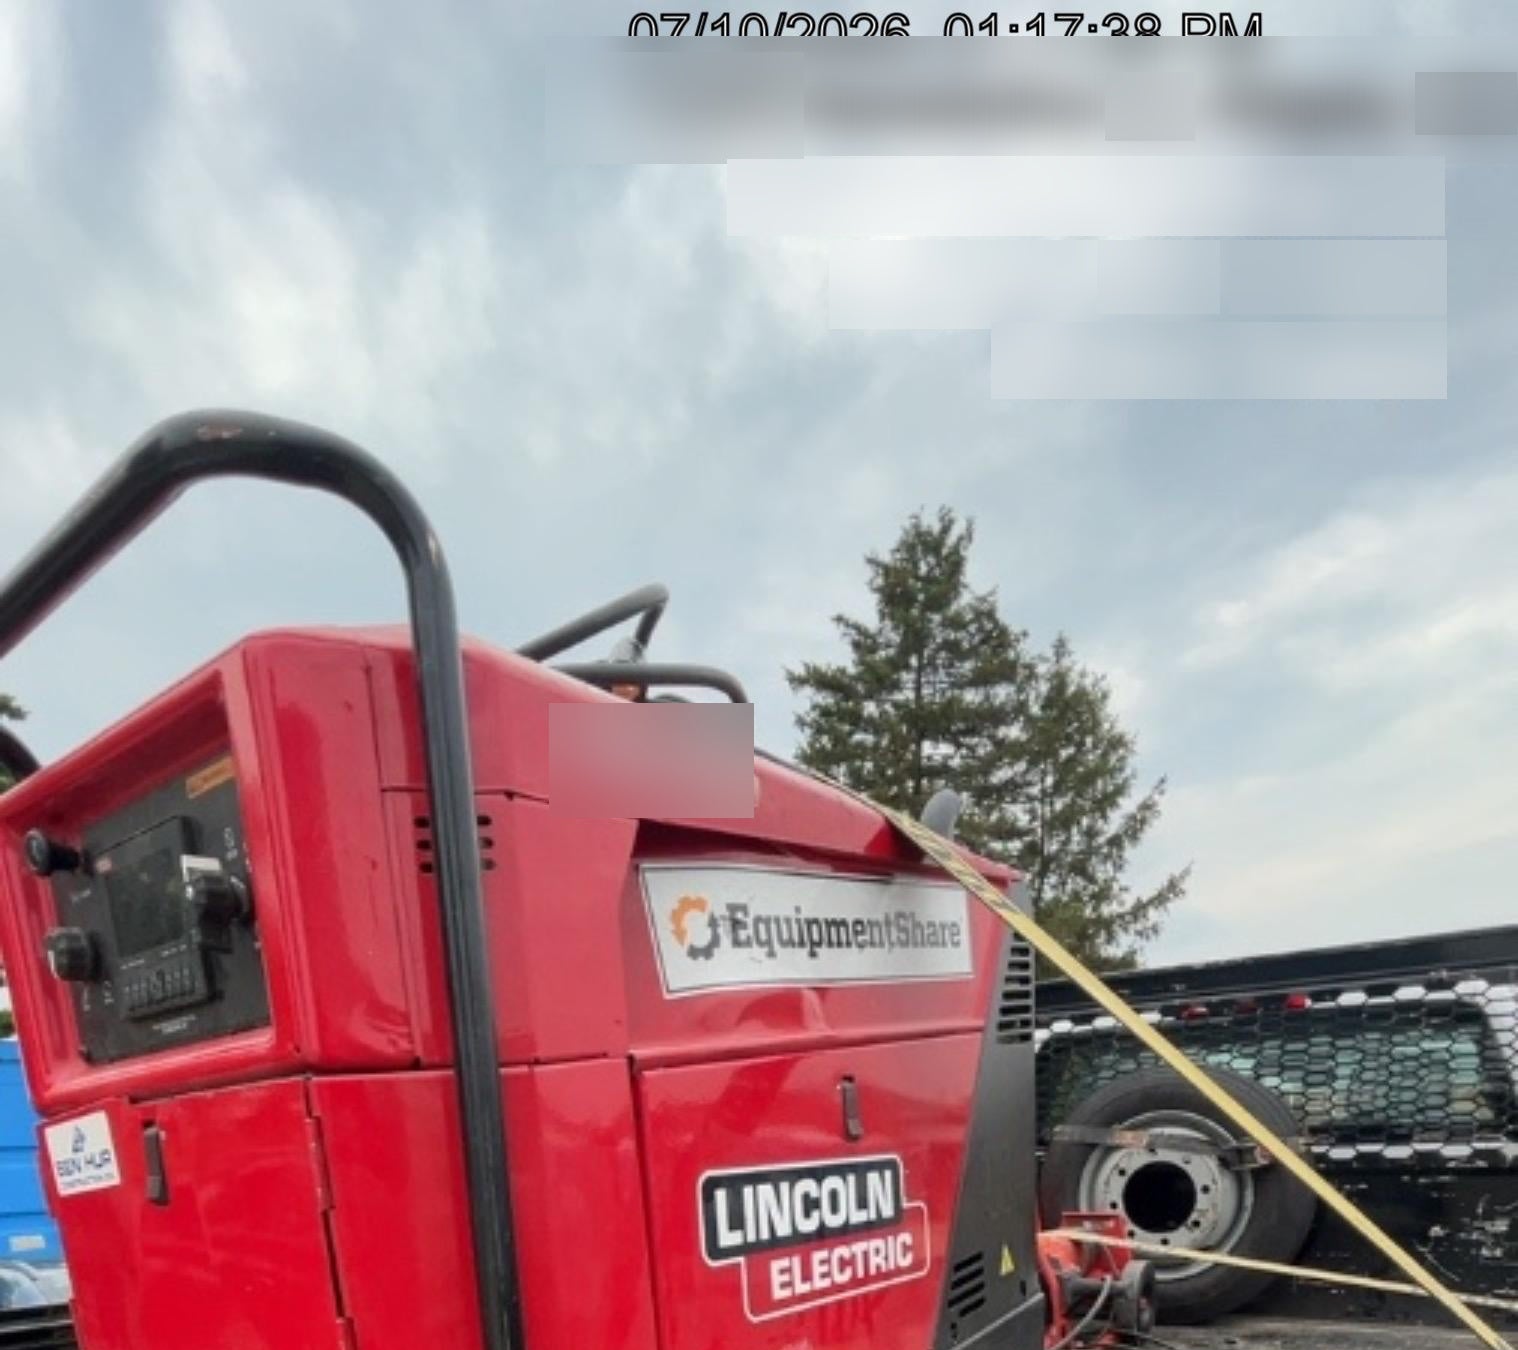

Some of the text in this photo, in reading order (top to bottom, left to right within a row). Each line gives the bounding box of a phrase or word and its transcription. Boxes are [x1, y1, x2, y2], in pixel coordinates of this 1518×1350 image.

[725, 902, 961, 959] EquipmentShare
[714, 1169, 895, 1249] LINCOLN
[769, 1231, 914, 1301] ELECTRIC
